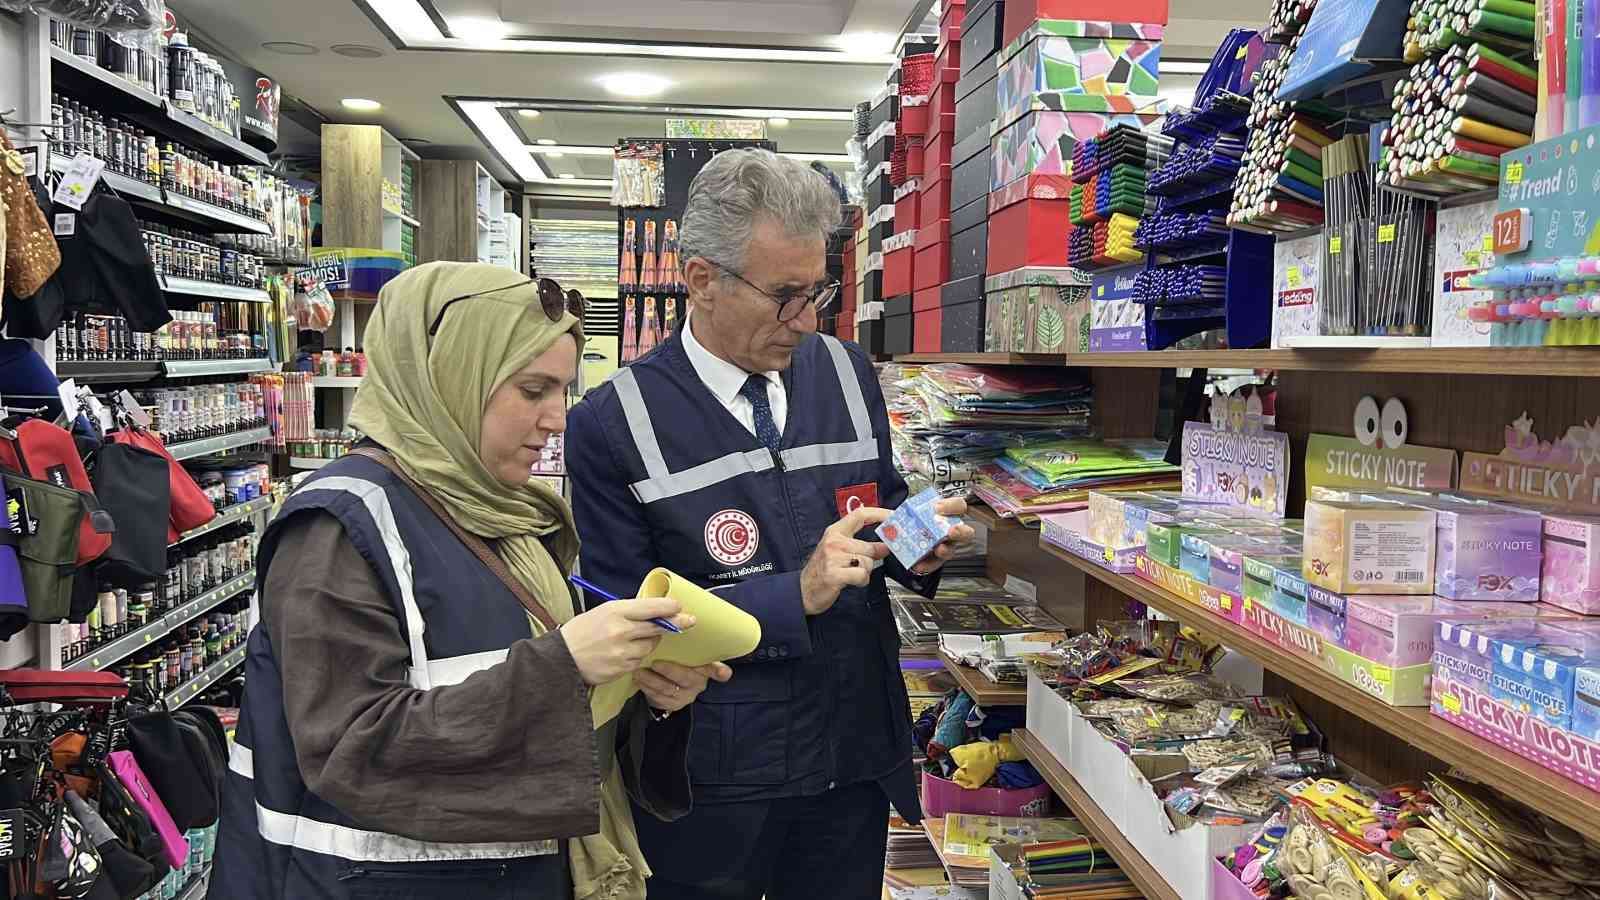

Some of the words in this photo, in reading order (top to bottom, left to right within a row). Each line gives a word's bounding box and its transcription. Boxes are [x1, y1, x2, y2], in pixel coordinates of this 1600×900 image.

[1497, 218, 1512, 247] 12
[1189, 431, 1238, 463] STICKY
[1238, 434, 1275, 472] NOTE
[1326, 449, 1382, 482] STICKY
[1384, 456, 1427, 488] NOTE
[1486, 458, 1584, 501] STICKY
[1461, 540, 1500, 551] STICKY
[1503, 540, 1534, 551] NOTE
[1434, 652, 1466, 673] STICKY
[1467, 663, 1490, 682] NOT
[1449, 679, 1530, 741] STICKY
[1493, 675, 1532, 699] STICKY
[1533, 691, 1566, 712] NOTE
